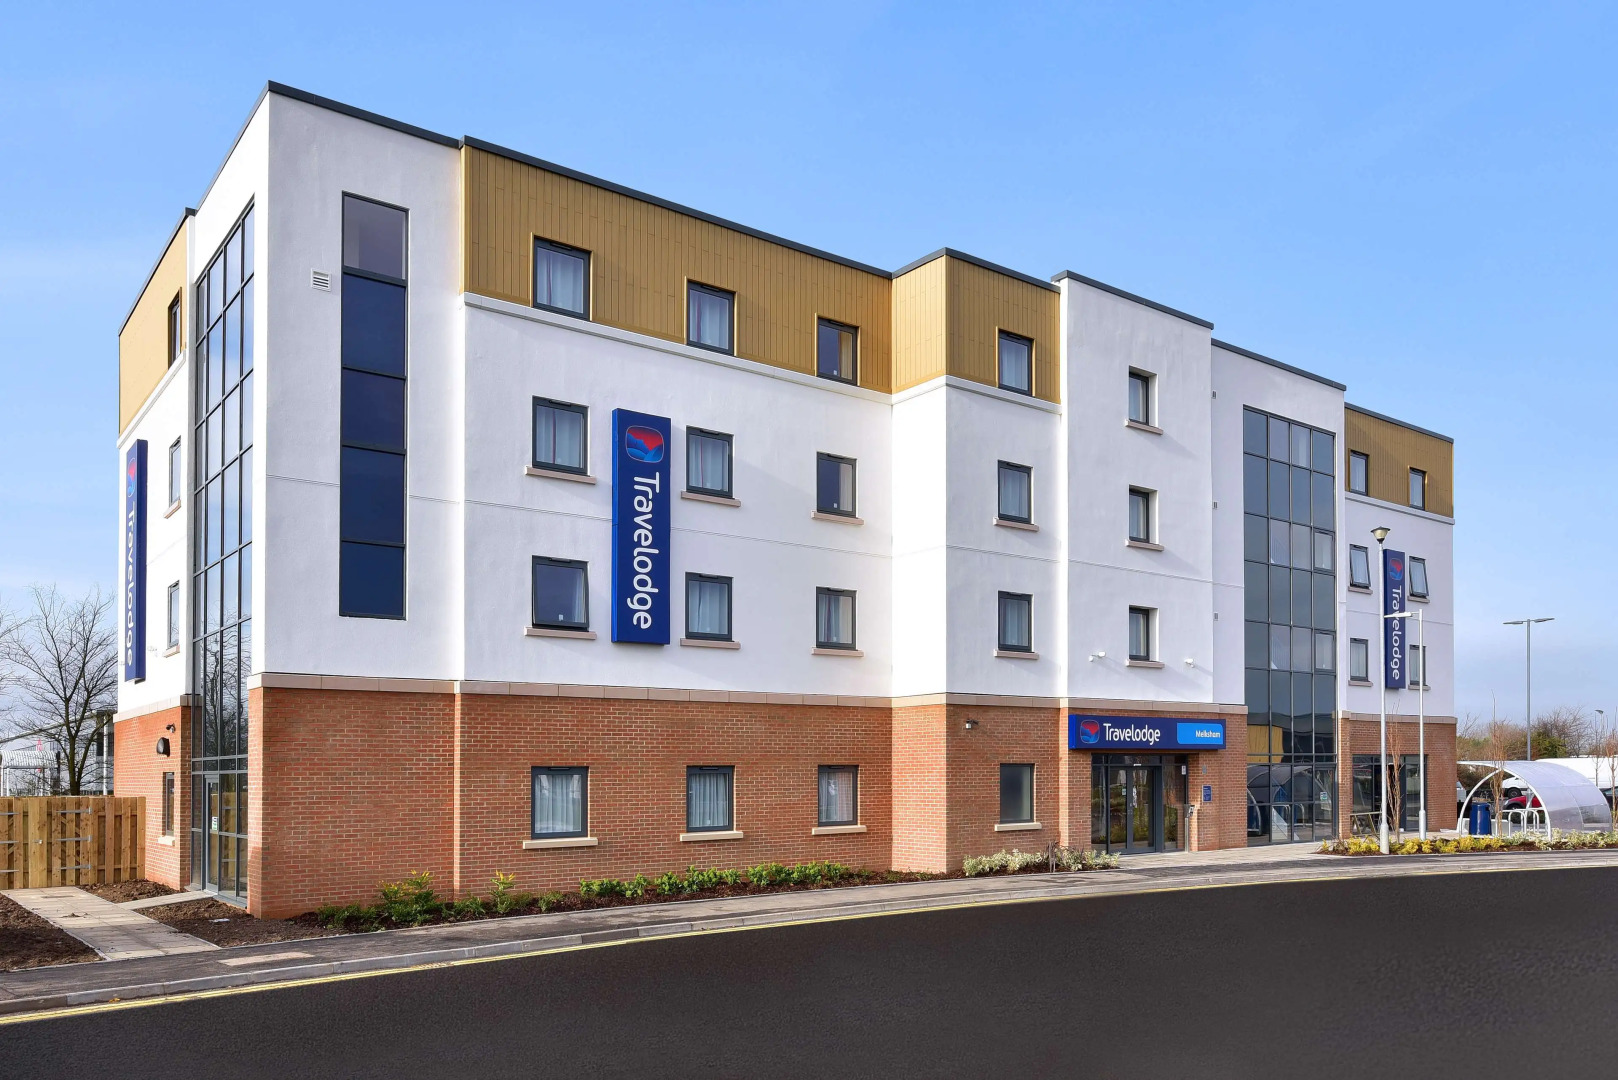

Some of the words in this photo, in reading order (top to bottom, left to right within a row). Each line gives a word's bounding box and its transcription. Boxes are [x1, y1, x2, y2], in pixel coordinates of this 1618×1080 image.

[126, 501, 136, 667] Travelodge
[627, 472, 660, 629] Travelodge
[1103, 723, 1161, 746] Travelodge
[1195, 730, 1221, 738] Melksham
